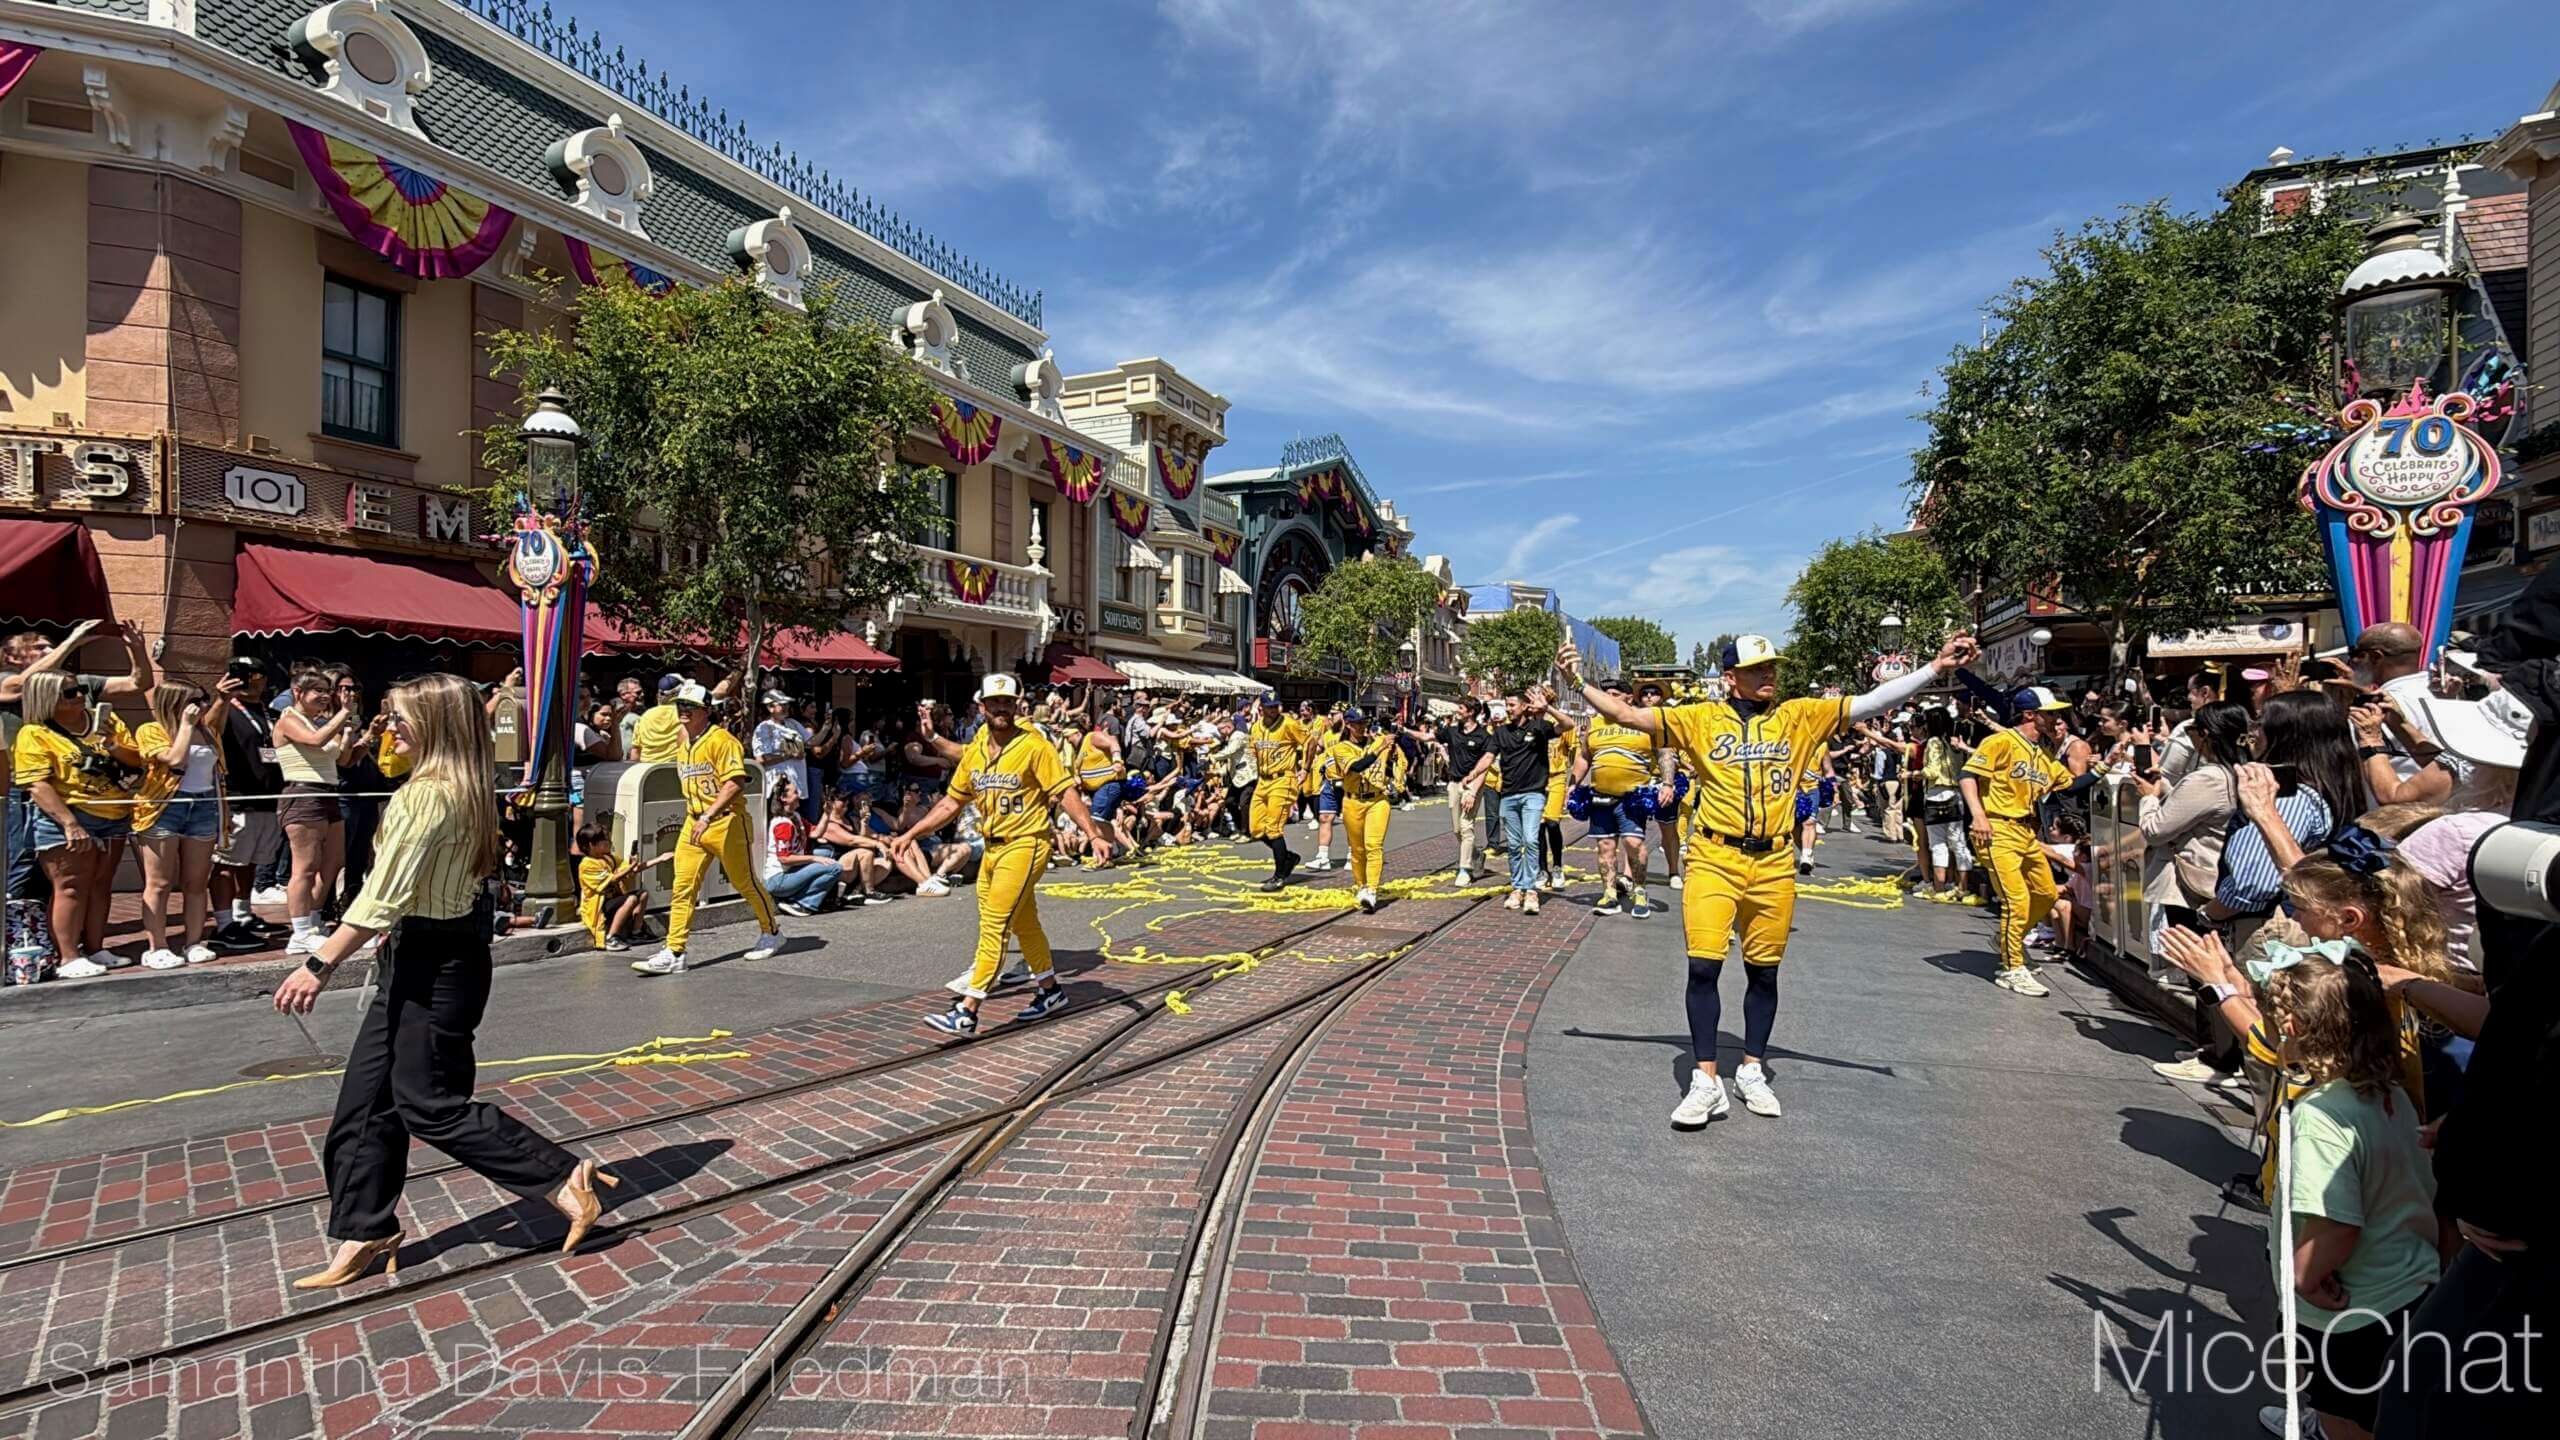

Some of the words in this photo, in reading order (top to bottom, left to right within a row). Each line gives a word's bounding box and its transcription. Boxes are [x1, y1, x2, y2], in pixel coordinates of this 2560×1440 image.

[2379, 416, 2455, 457] 70
[2372, 460, 2448, 476] CELEBRATE
[2388, 472, 2434, 485] HAPPY
[234, 475, 294, 508] 101
[518, 530, 546, 556] 70
[1103, 610, 1142, 632] SOUVENIRS
[1770, 767, 1792, 795] 88
